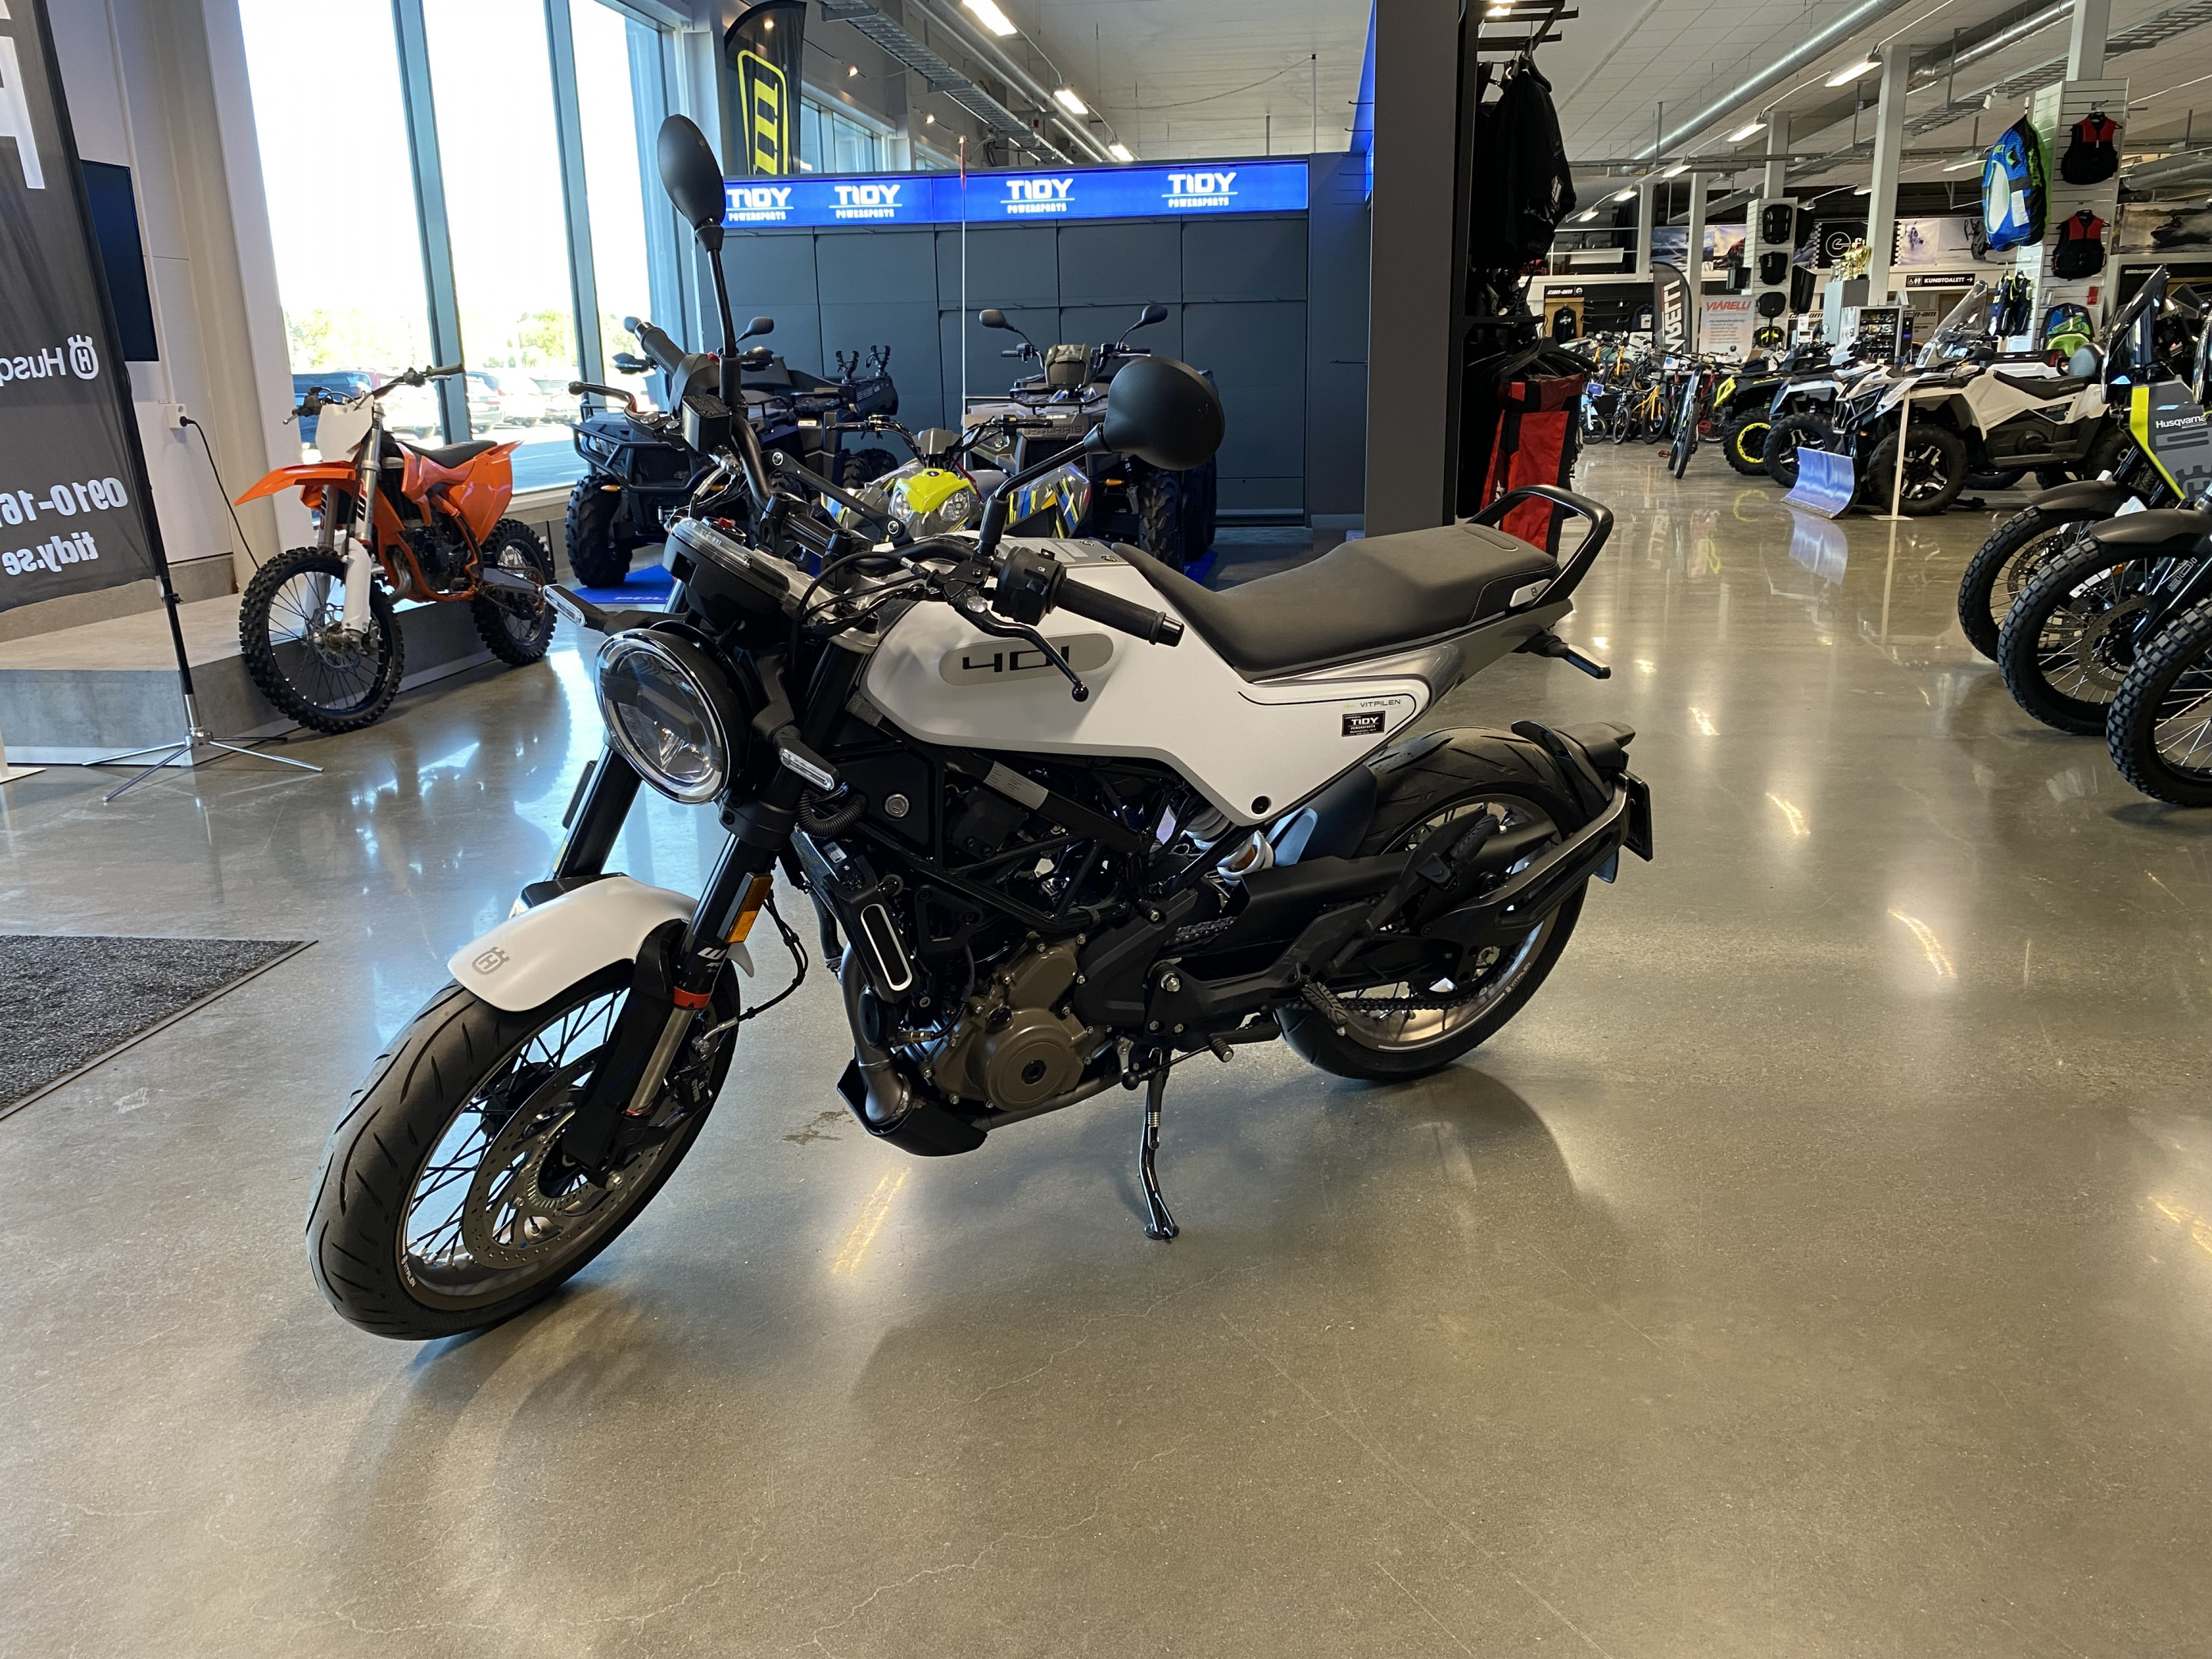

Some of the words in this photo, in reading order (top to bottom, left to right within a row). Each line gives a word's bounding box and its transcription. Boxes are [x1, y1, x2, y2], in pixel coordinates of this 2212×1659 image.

[1006, 178, 1074, 200] TIDY
[1167, 172, 1237, 194] TIDY
[727, 187, 792, 208] TIDY
[834, 184, 901, 205] TIDY
[1168, 197, 1229, 207] POWERSPORTS
[836, 208, 894, 219] POWERSPORTS
[1007, 203, 1067, 214] POWERSPORTS
[728, 211, 786, 222] POWERSPORTS
[2155, 415, 2206, 429] Husqvarna
[962, 645, 1070, 673] 401
[1360, 699, 1401, 707] VITPILEN
[1351, 717, 1379, 726] TIDY
